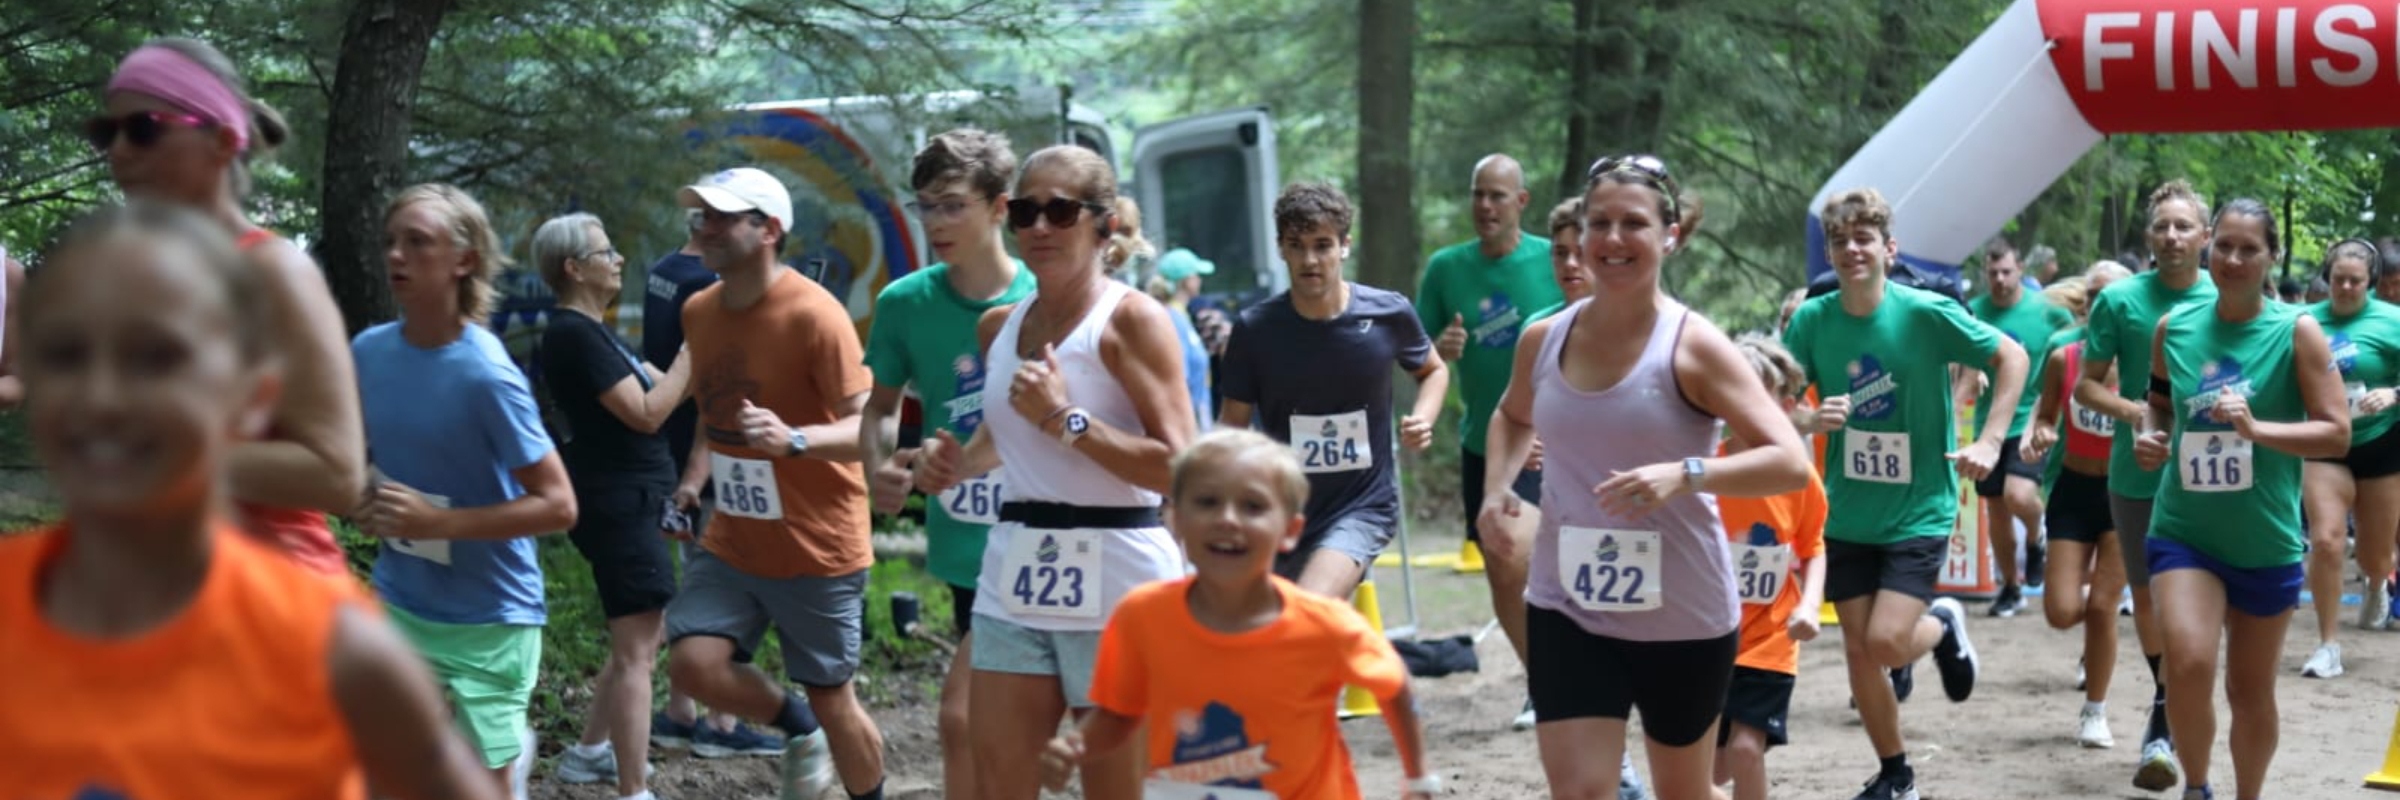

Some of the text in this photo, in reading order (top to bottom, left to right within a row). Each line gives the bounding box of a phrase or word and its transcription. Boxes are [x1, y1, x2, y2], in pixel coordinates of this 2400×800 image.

[2083, 3, 2400, 91] FINIS
[1303, 437, 1358, 467] 264
[1853, 451, 1899, 477] 618
[2189, 456, 2241, 485] 116
[722, 481, 768, 514] 486
[1013, 566, 1083, 607] 423
[1574, 563, 1644, 604] 422
[1738, 571, 1776, 598] 30
